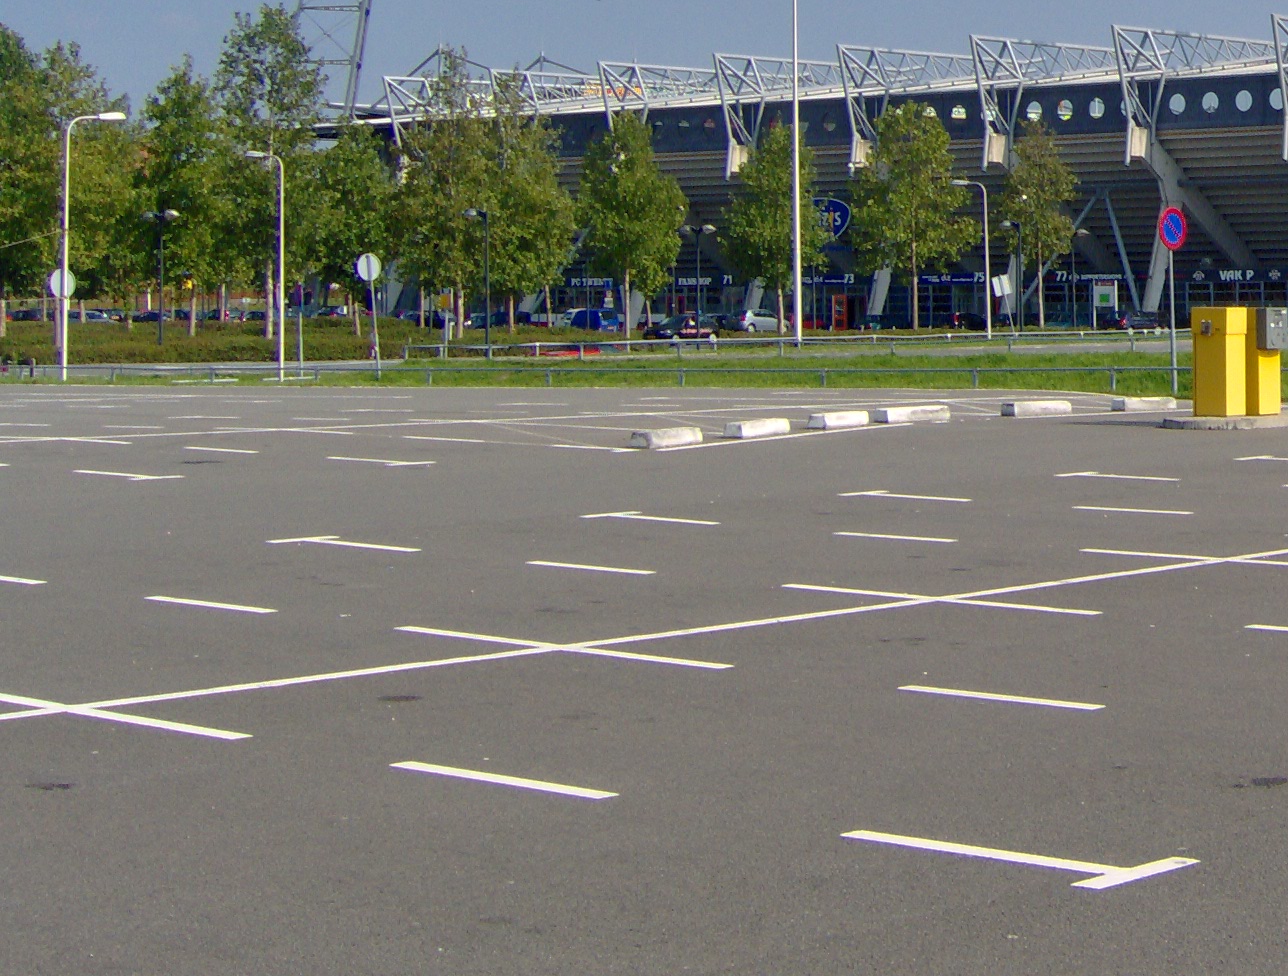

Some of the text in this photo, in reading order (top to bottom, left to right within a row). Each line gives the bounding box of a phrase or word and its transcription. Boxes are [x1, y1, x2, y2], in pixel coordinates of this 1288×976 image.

[722, 274, 733, 285] 71
[844, 273, 855, 284] 73
[973, 271, 985, 283] 75
[1055, 270, 1067, 282] 77
[1219, 269, 1255, 282] VAK P
